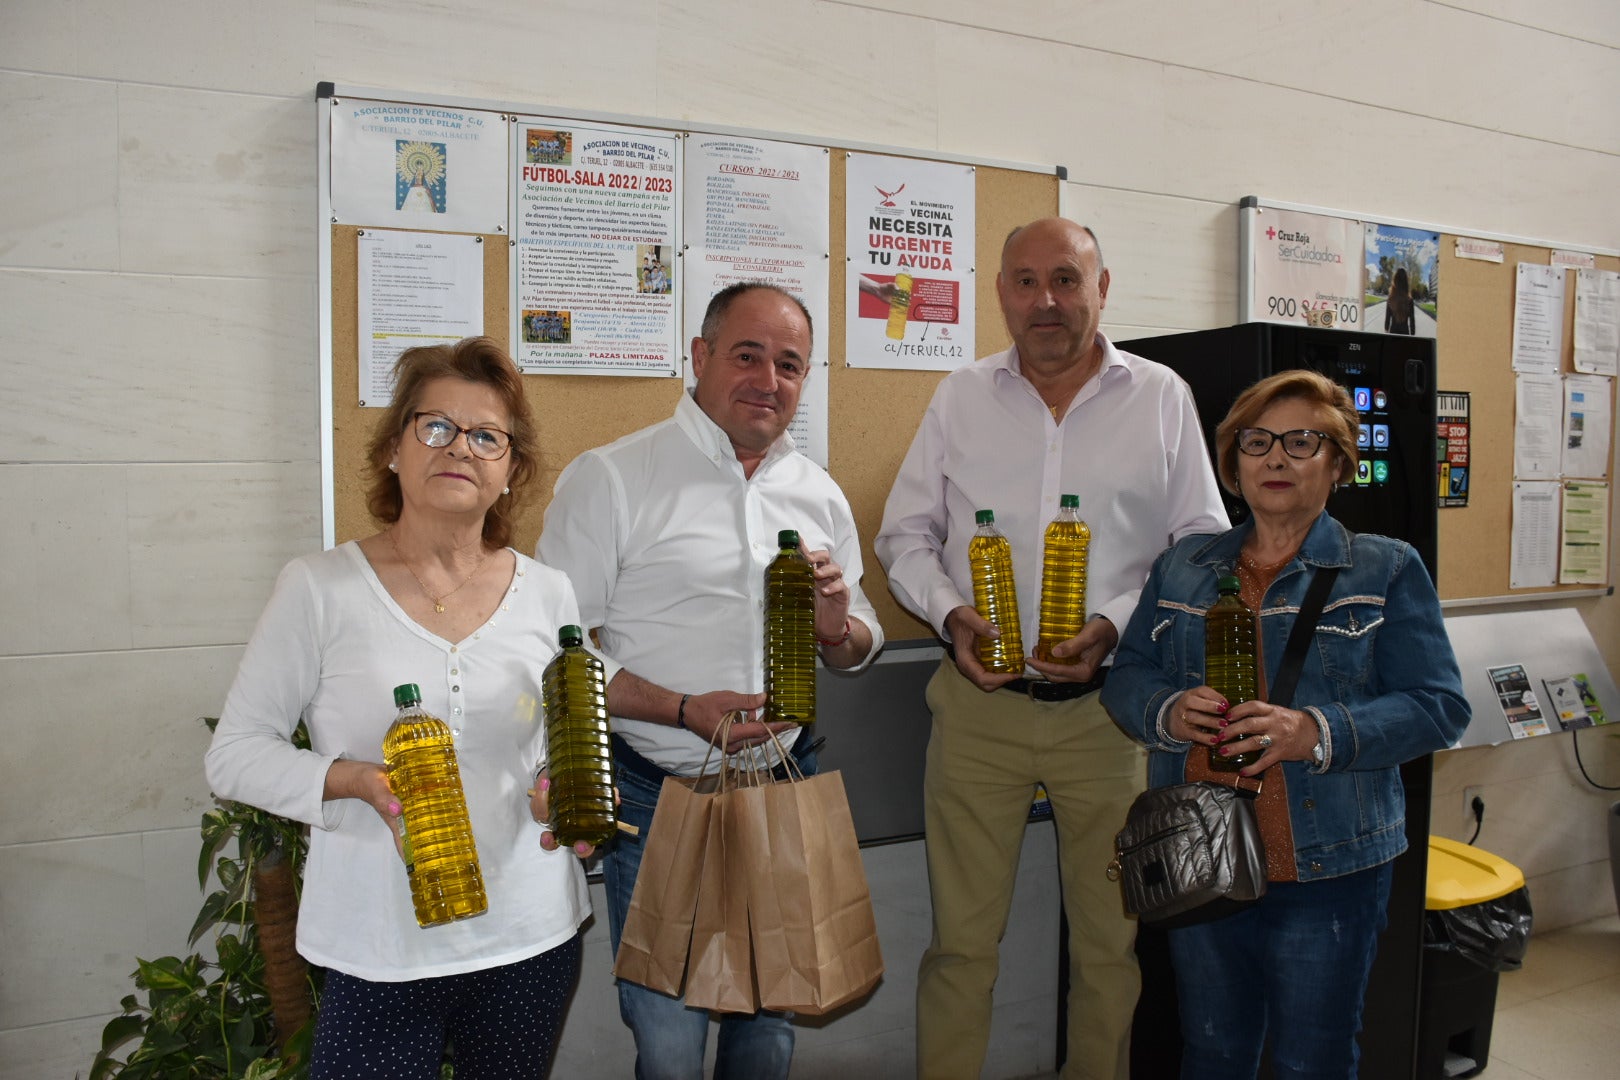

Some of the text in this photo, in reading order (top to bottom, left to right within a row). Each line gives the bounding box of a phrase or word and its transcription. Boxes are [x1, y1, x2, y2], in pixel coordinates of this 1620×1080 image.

[354, 107, 410, 118] ASOCIACION
[412, 107, 424, 115] DE
[426, 110, 464, 120] VECINOS
[437, 120, 461, 129] PILAR
[583, 140, 620, 152] ASOCIACION
[631, 143, 656, 153] VECINOS
[637, 152, 654, 161] PILAR
[720, 163, 755, 174] CURSOS
[758, 167, 776, 176] 2022
[782, 170, 799, 179] 2023
[522, 163, 605, 186] FÚTBOL-SALA
[645, 177, 673, 193] 2023
[526, 184, 563, 194] Seguimos
[617, 191, 650, 201] campaña
[522, 193, 563, 203] Asociación
[575, 197, 602, 206] Vecinos
[617, 200, 639, 208] Barrio
[919, 202, 954, 210] MOVIMIENTO
[533, 212, 557, 220] diversión
[563, 215, 585, 223] deporte,
[910, 209, 953, 221] VECINAL
[870, 216, 952, 238] NECESITA
[602, 234, 621, 242] DEJAR
[1278, 230, 1310, 245] Cruz Roja
[520, 238, 634, 251] OBJETIVOS DEL PILAR
[869, 234, 952, 255] URGENTE
[706, 254, 752, 264] INSCRIPCIONES
[869, 251, 952, 271] TU AYUDA
[1268, 296, 1296, 317] 900
[623, 353, 664, 361] LIMITADAS
[1449, 426, 1467, 437] STOP
[1451, 454, 1466, 462] JAZZ
